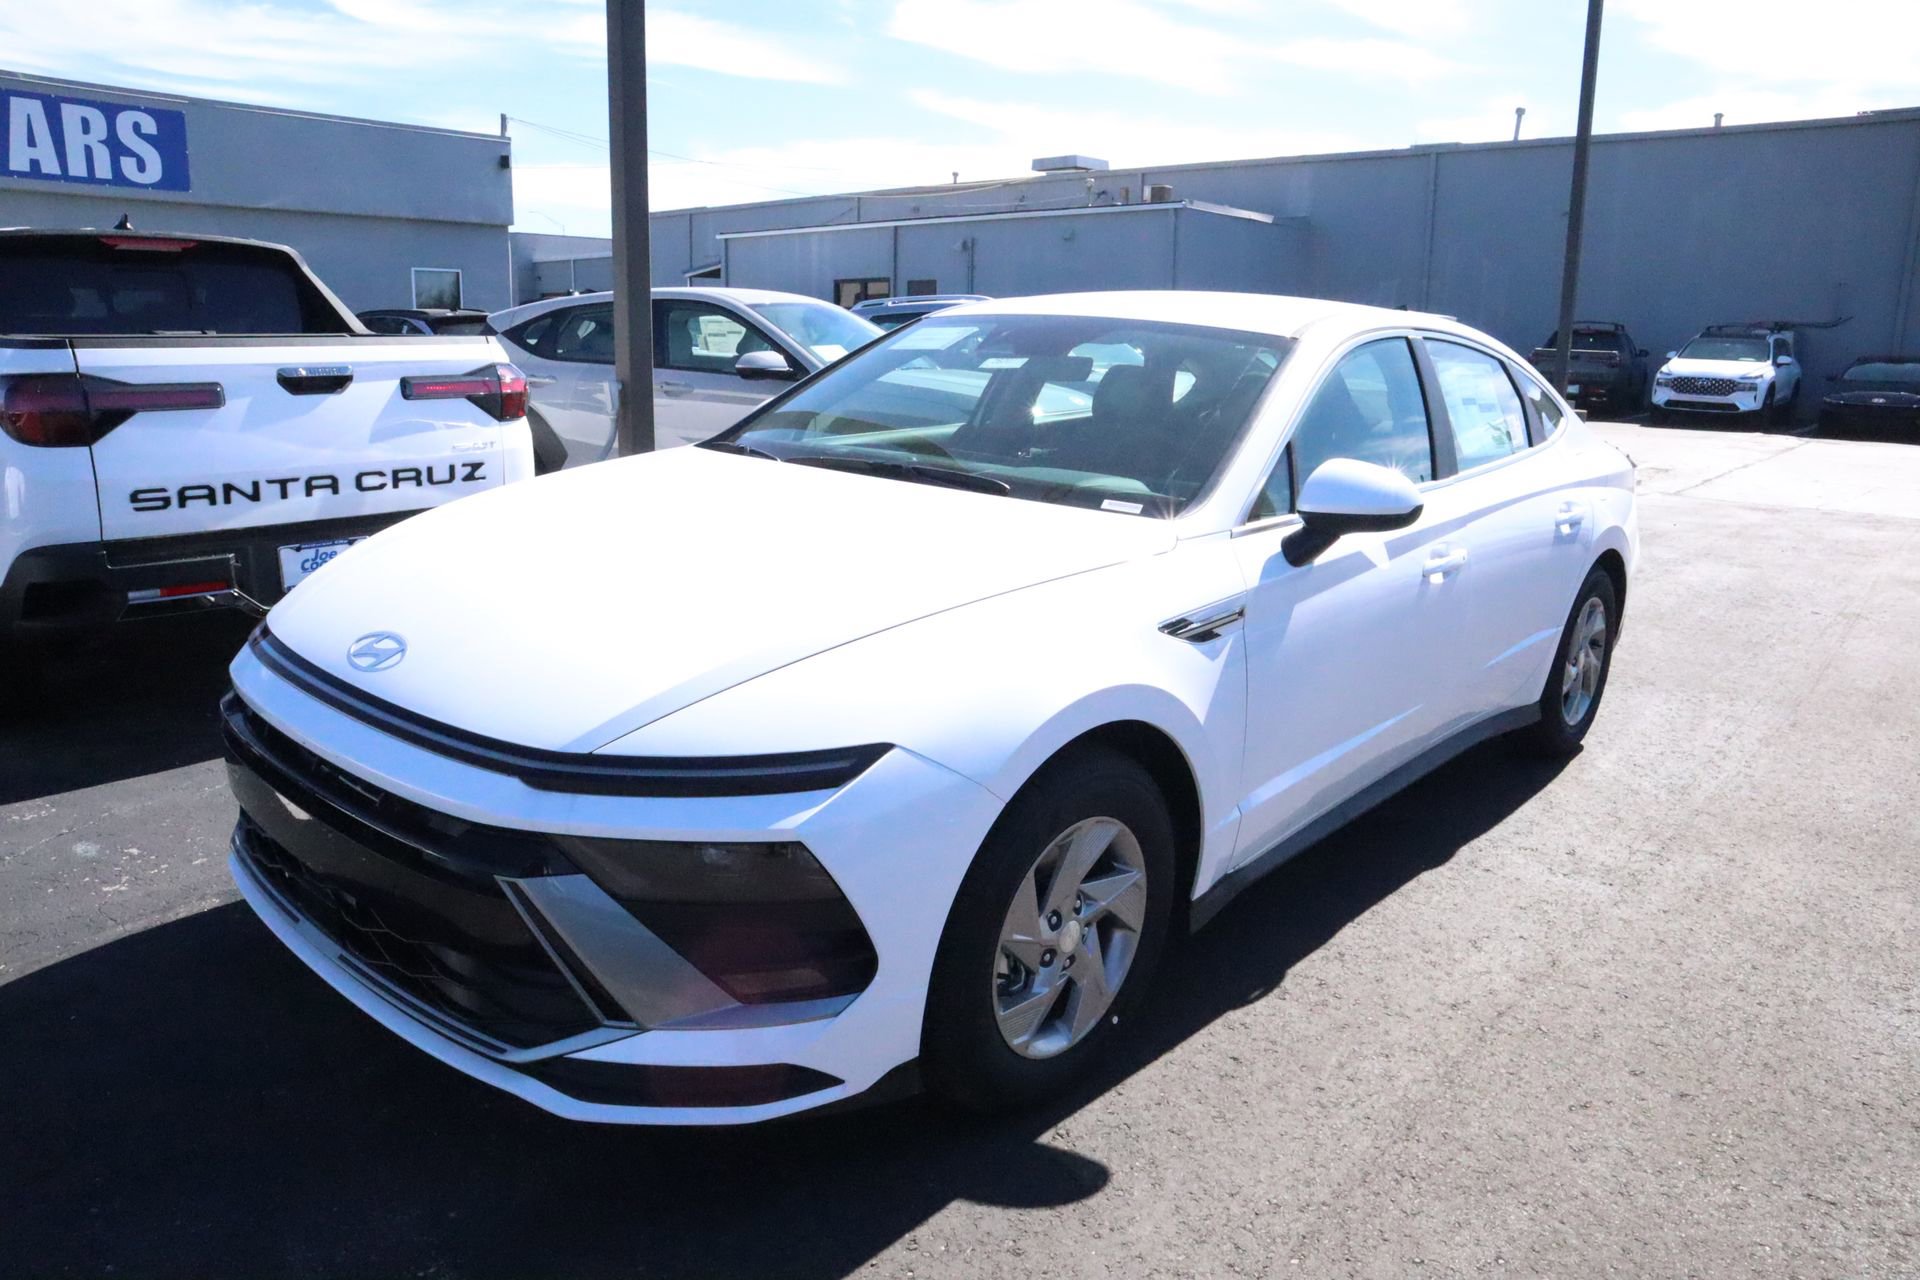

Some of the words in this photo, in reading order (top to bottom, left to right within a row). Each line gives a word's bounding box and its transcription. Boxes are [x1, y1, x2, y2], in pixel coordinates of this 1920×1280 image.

[9, 96, 163, 184] ARS
[129, 474, 340, 512] SANTA
[354, 462, 486, 492] CRUZ
[311, 549, 338, 561] Joe
